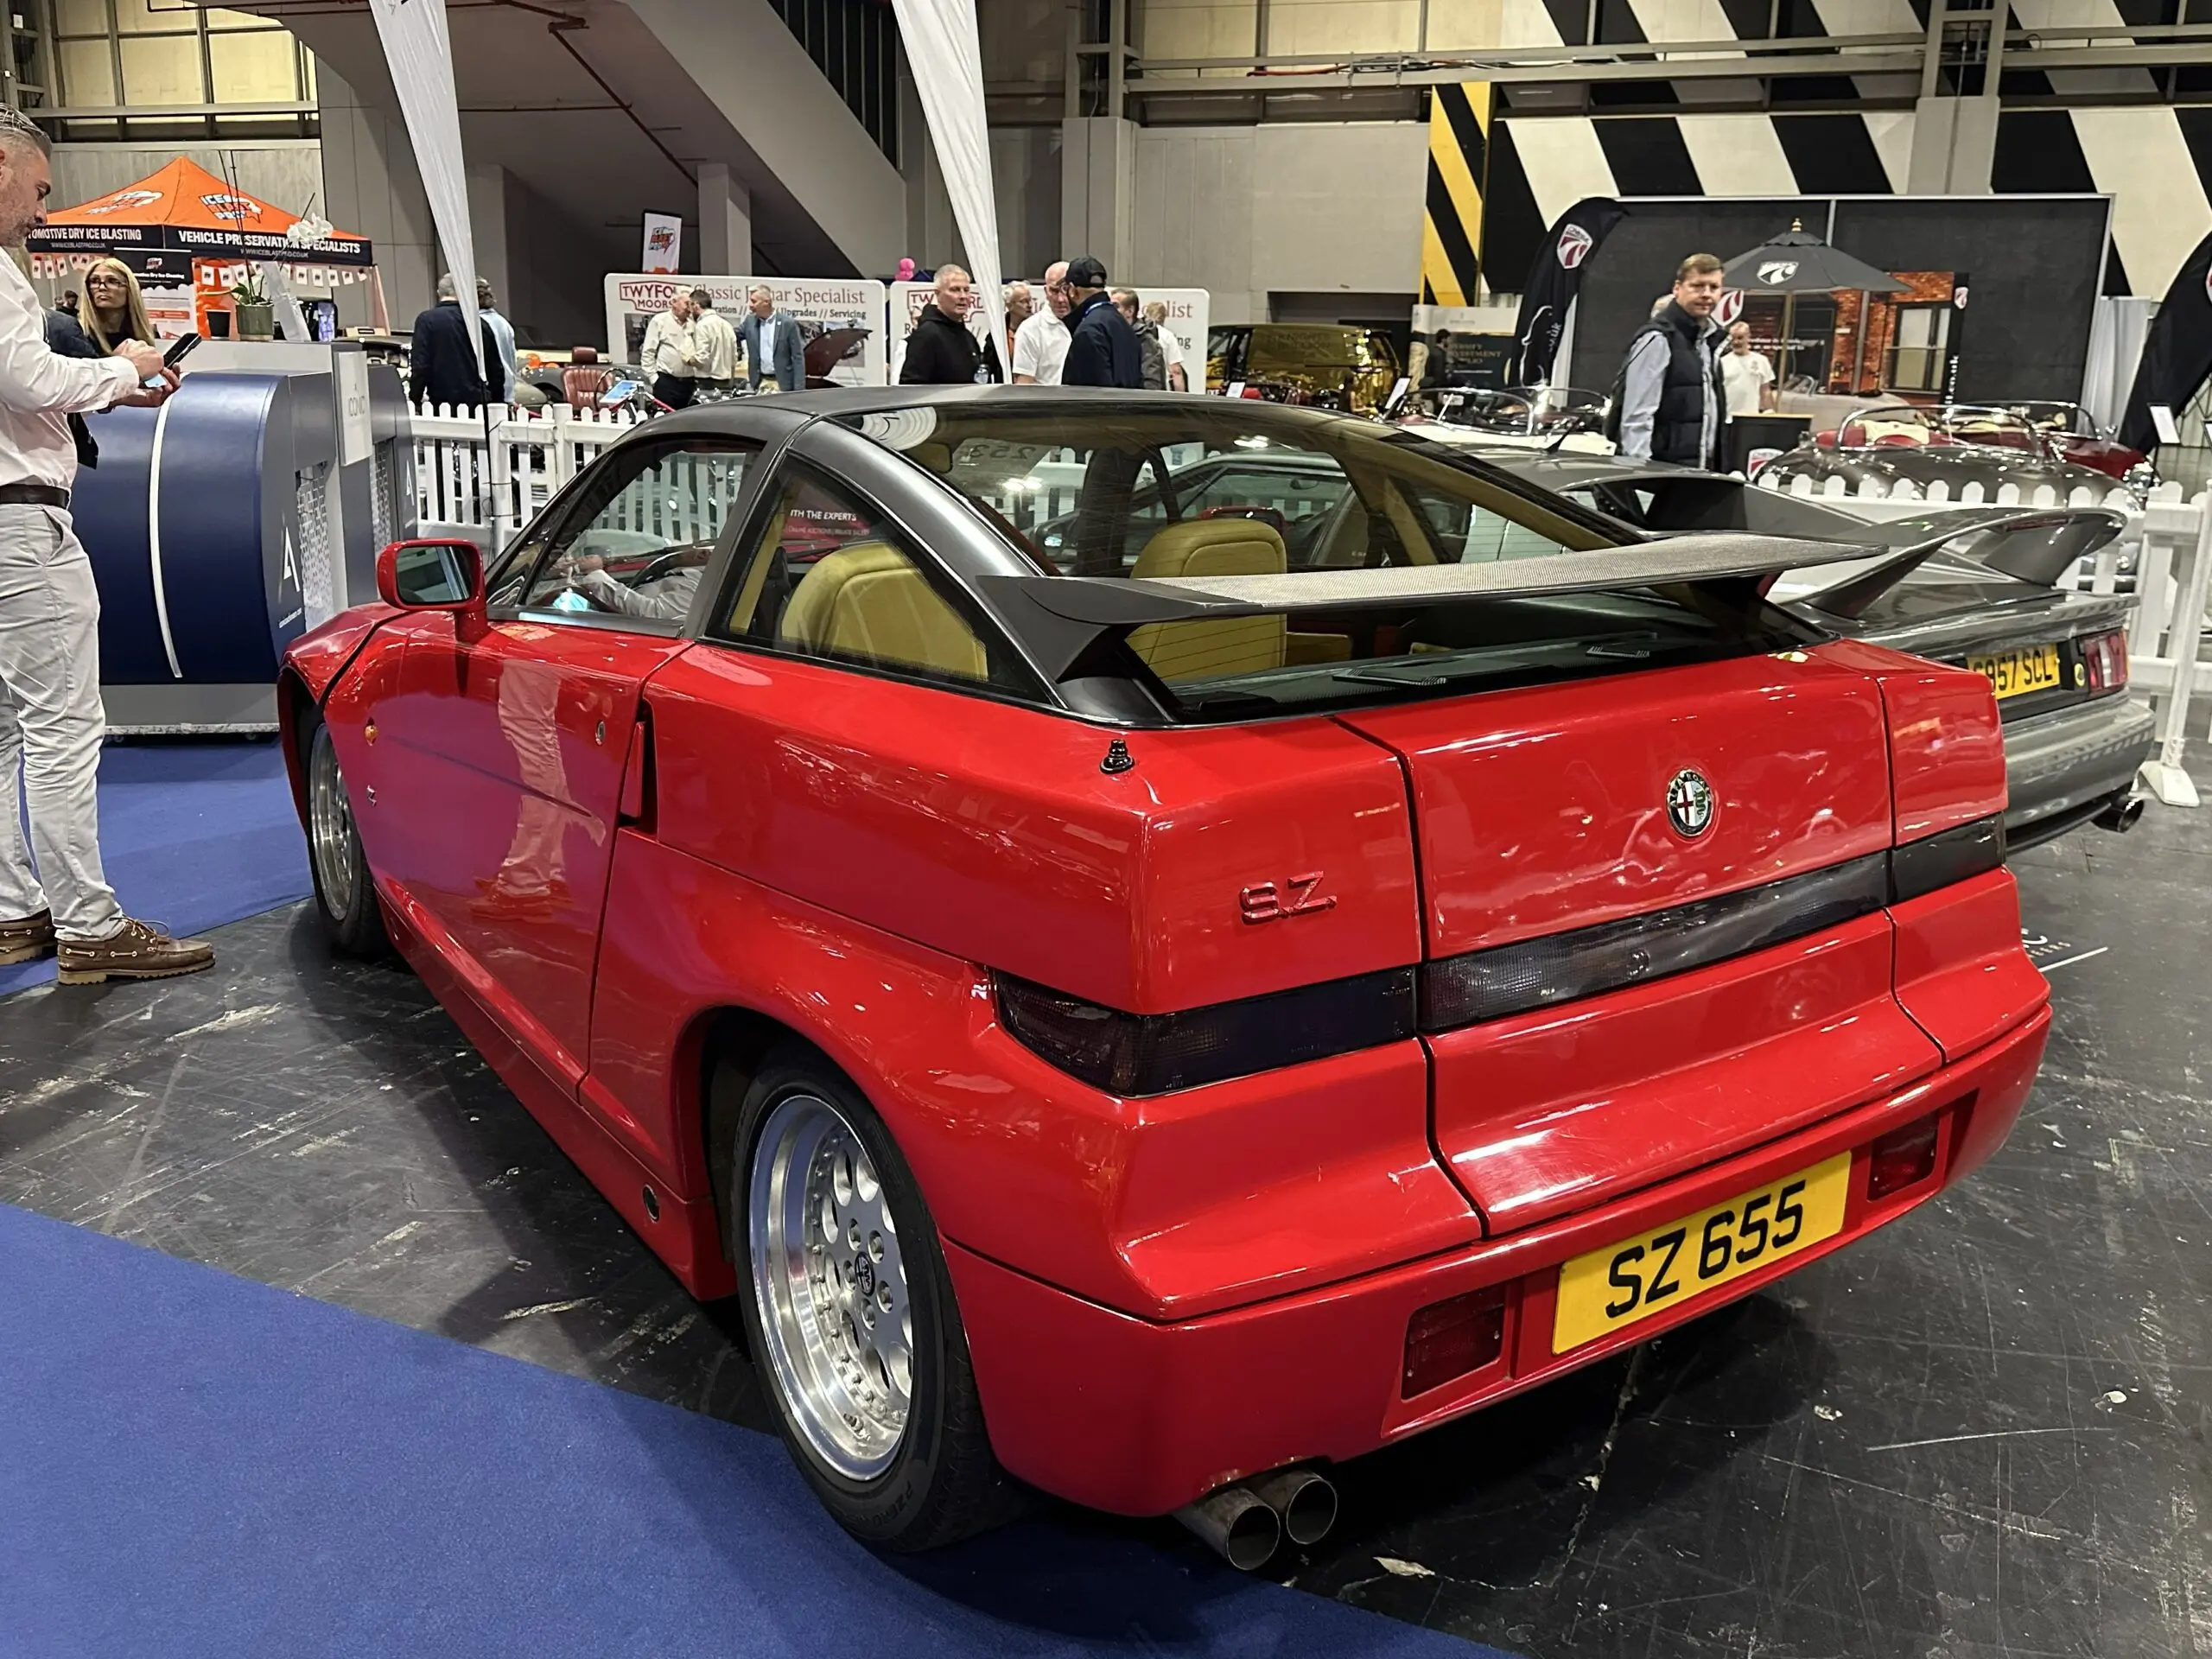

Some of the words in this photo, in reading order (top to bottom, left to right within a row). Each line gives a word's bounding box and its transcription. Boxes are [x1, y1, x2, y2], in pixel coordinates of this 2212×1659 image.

[29, 227, 67, 240] TOMOTIVE
[68, 227, 85, 240] DRY
[86, 228, 99, 240] ICE
[101, 228, 143, 241] BLASTING
[178, 230, 224, 245] VEHICLE
[300, 238, 361, 254] SPECIALISTS
[622, 284, 677, 299] TWYFO
[794, 287, 866, 306] Specialist
[830, 308, 867, 320] Servicing
[790, 509, 805, 518] ITH
[806, 510, 823, 520] THE
[823, 512, 857, 522] EXPERTS
[2023, 648, 2053, 686] SCL
[1605, 1226, 1688, 1319] SZ
[1698, 1179, 1807, 1281] 655
